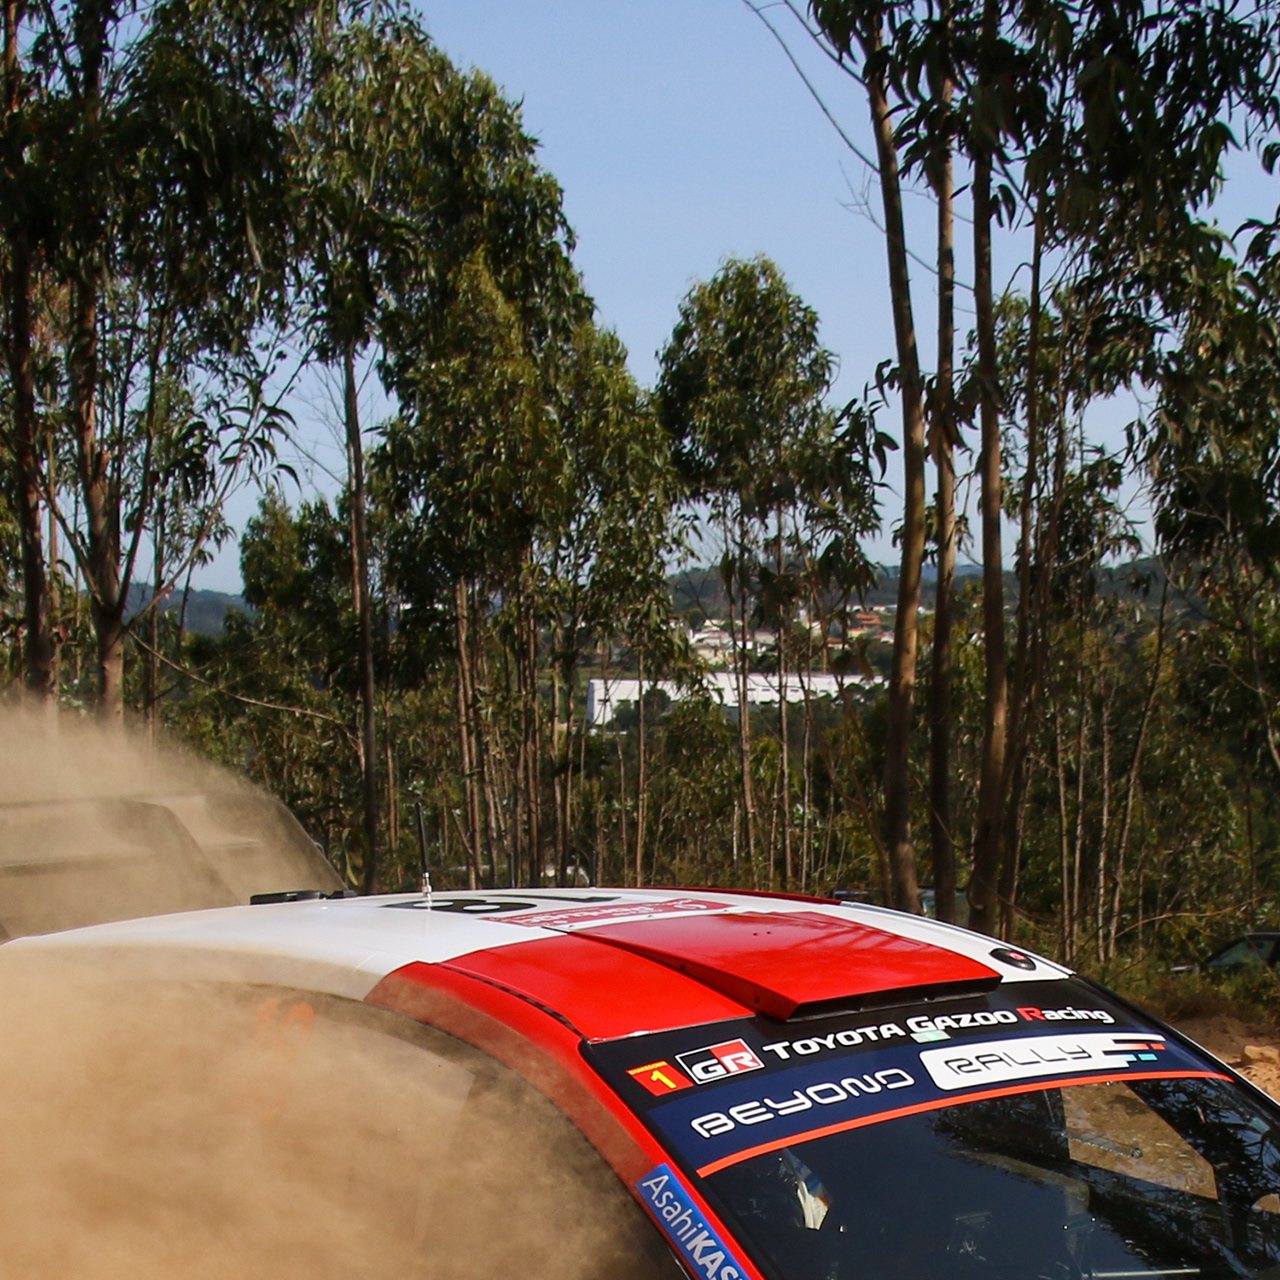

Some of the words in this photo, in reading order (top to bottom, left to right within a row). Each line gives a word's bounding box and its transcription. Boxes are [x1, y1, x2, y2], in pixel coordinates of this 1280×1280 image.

[763, 1023, 906, 1061] TOYOTA
[906, 1008, 1018, 1033] GAZOO
[1017, 1006, 1116, 1025] Racing
[691, 1051, 758, 1080] GR
[945, 1043, 1093, 1075] RALLY
[650, 1070, 677, 1089] 1
[690, 1067, 915, 1139] BEYOND
